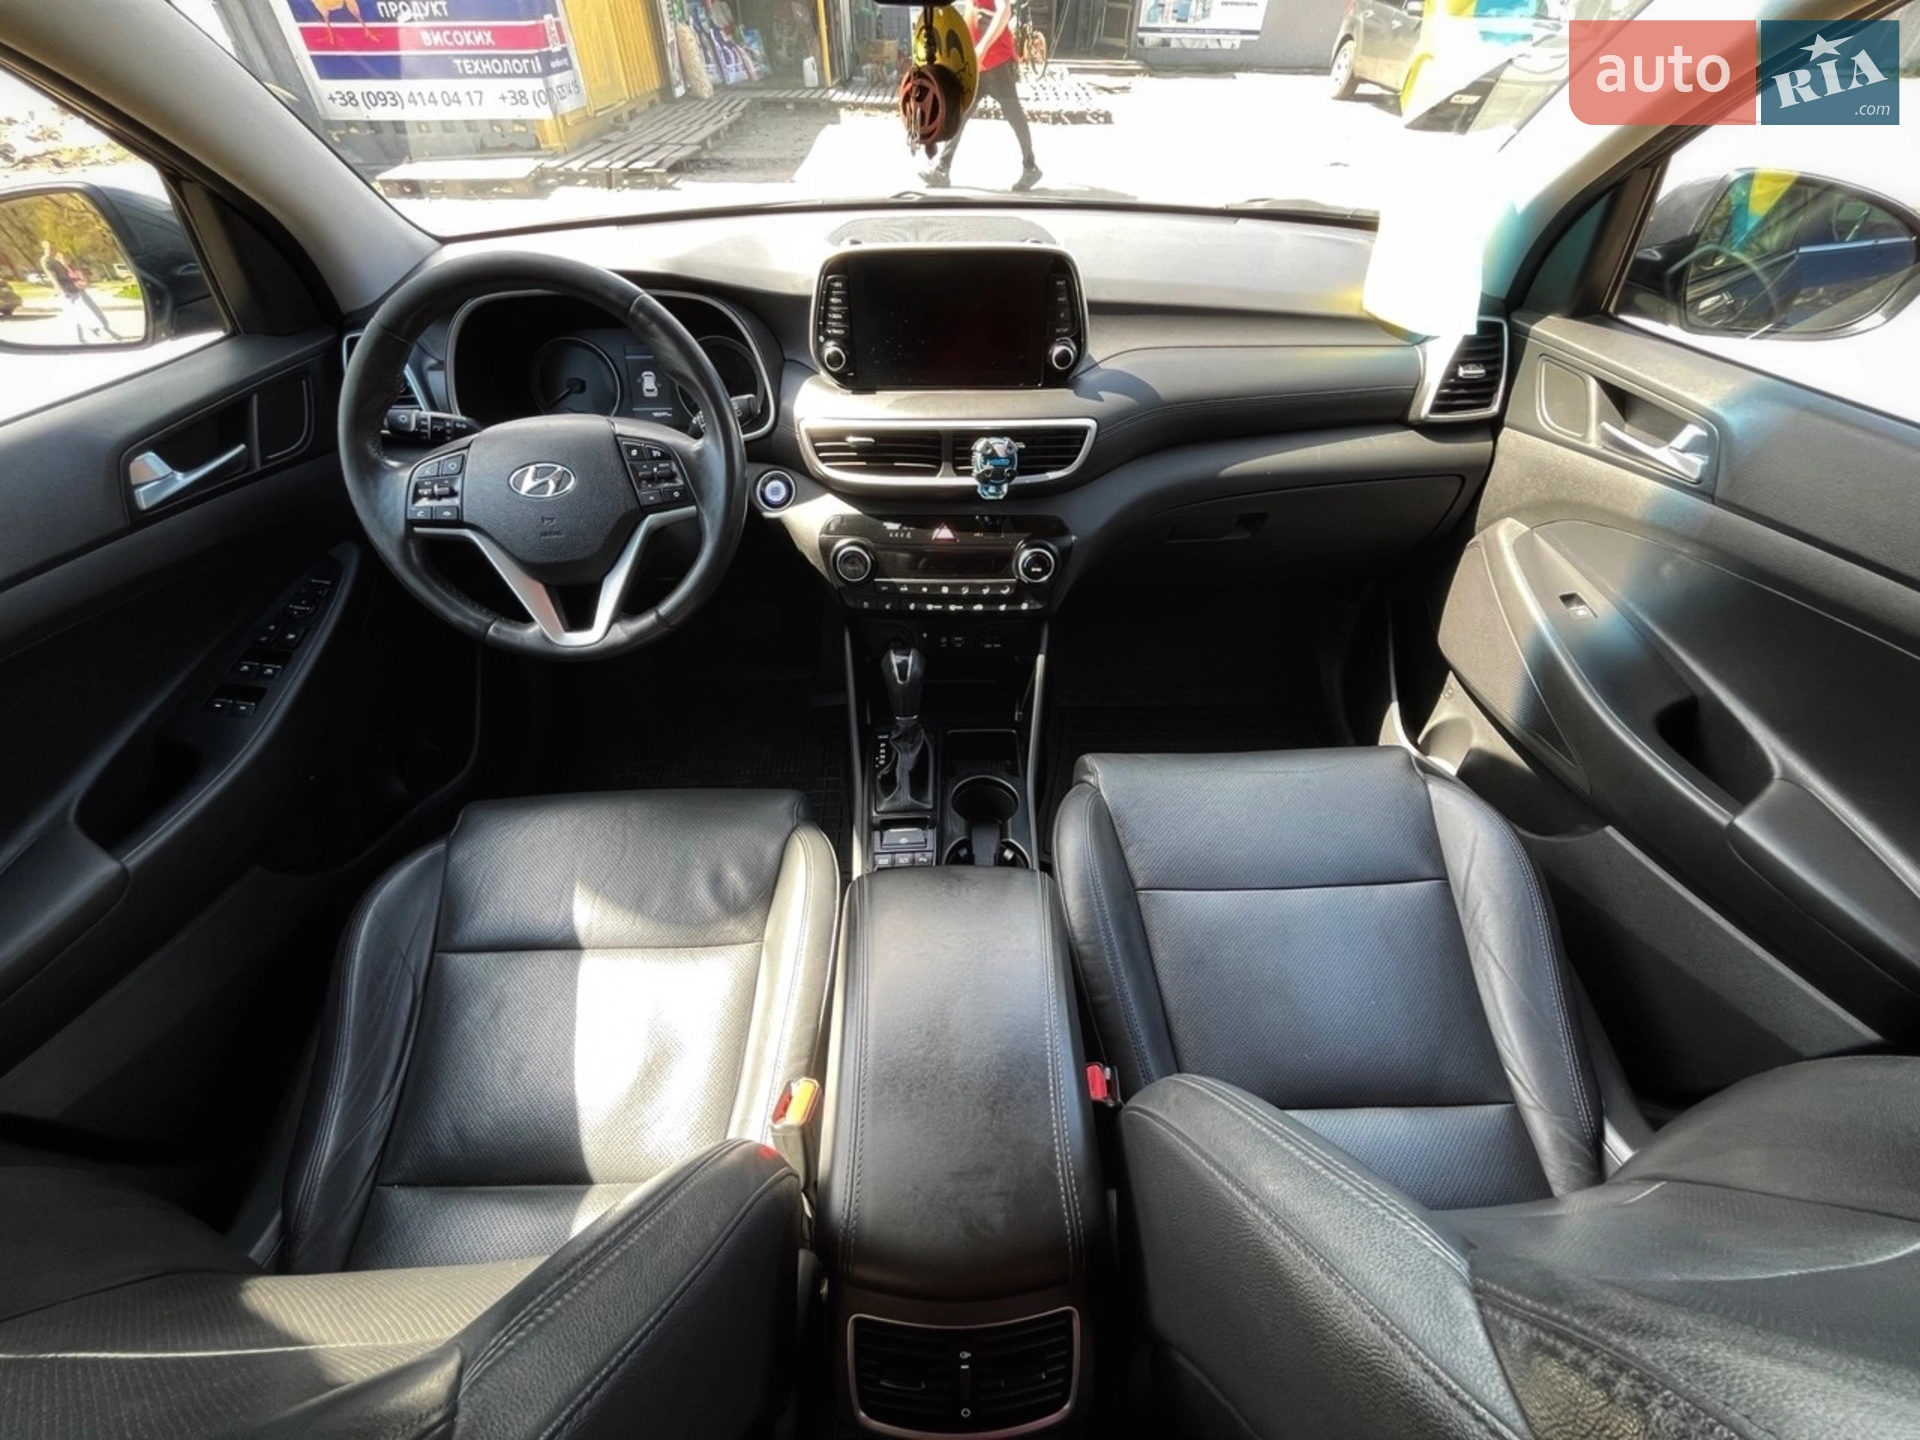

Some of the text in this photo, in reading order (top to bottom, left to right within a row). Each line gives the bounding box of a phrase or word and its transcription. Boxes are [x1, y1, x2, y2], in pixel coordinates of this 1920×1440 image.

[377, 1, 449, 19] ПРОДУКТ
[420, 30, 495, 46] ВИСОКИХ
[327, 91, 359, 107] +38
[361, 91, 405, 110] (093)
[408, 91, 438, 106] 414
[440, 91, 461, 107] 04
[465, 91, 483, 106] 17
[499, 90, 529, 106] +38
